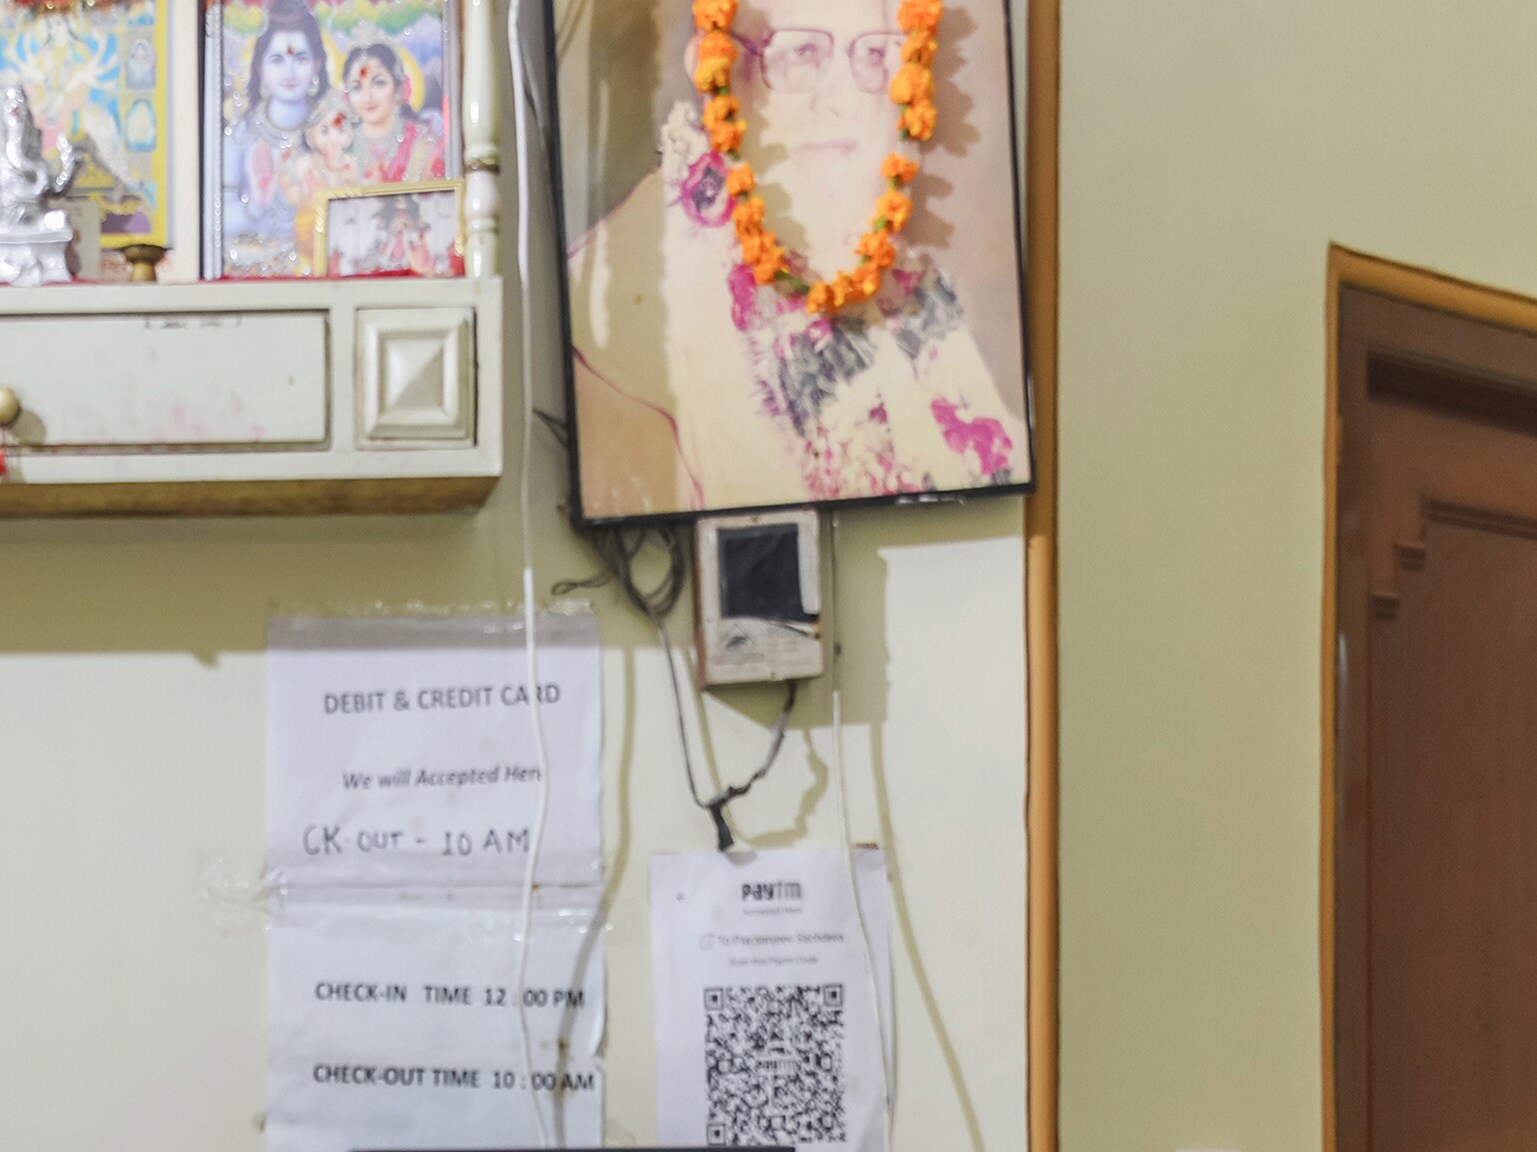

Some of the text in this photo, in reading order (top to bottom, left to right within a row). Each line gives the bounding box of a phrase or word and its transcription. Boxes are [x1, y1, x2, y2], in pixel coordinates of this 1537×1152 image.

[324, 690, 385, 714] DEBIT
[393, 688, 410, 711] &
[416, 686, 494, 710] CREDIT
[342, 771, 372, 790] We
[377, 767, 412, 788] will
[415, 765, 500, 788] Accepted
[441, 830, 473, 857] 10
[314, 981, 408, 1003] CHECK-IN
[423, 984, 472, 1006] TIME
[552, 987, 586, 1010] PM
[313, 1062, 425, 1087] CHECK-OUT
[431, 1067, 481, 1089] TIME
[560, 1072, 596, 1092] AM
